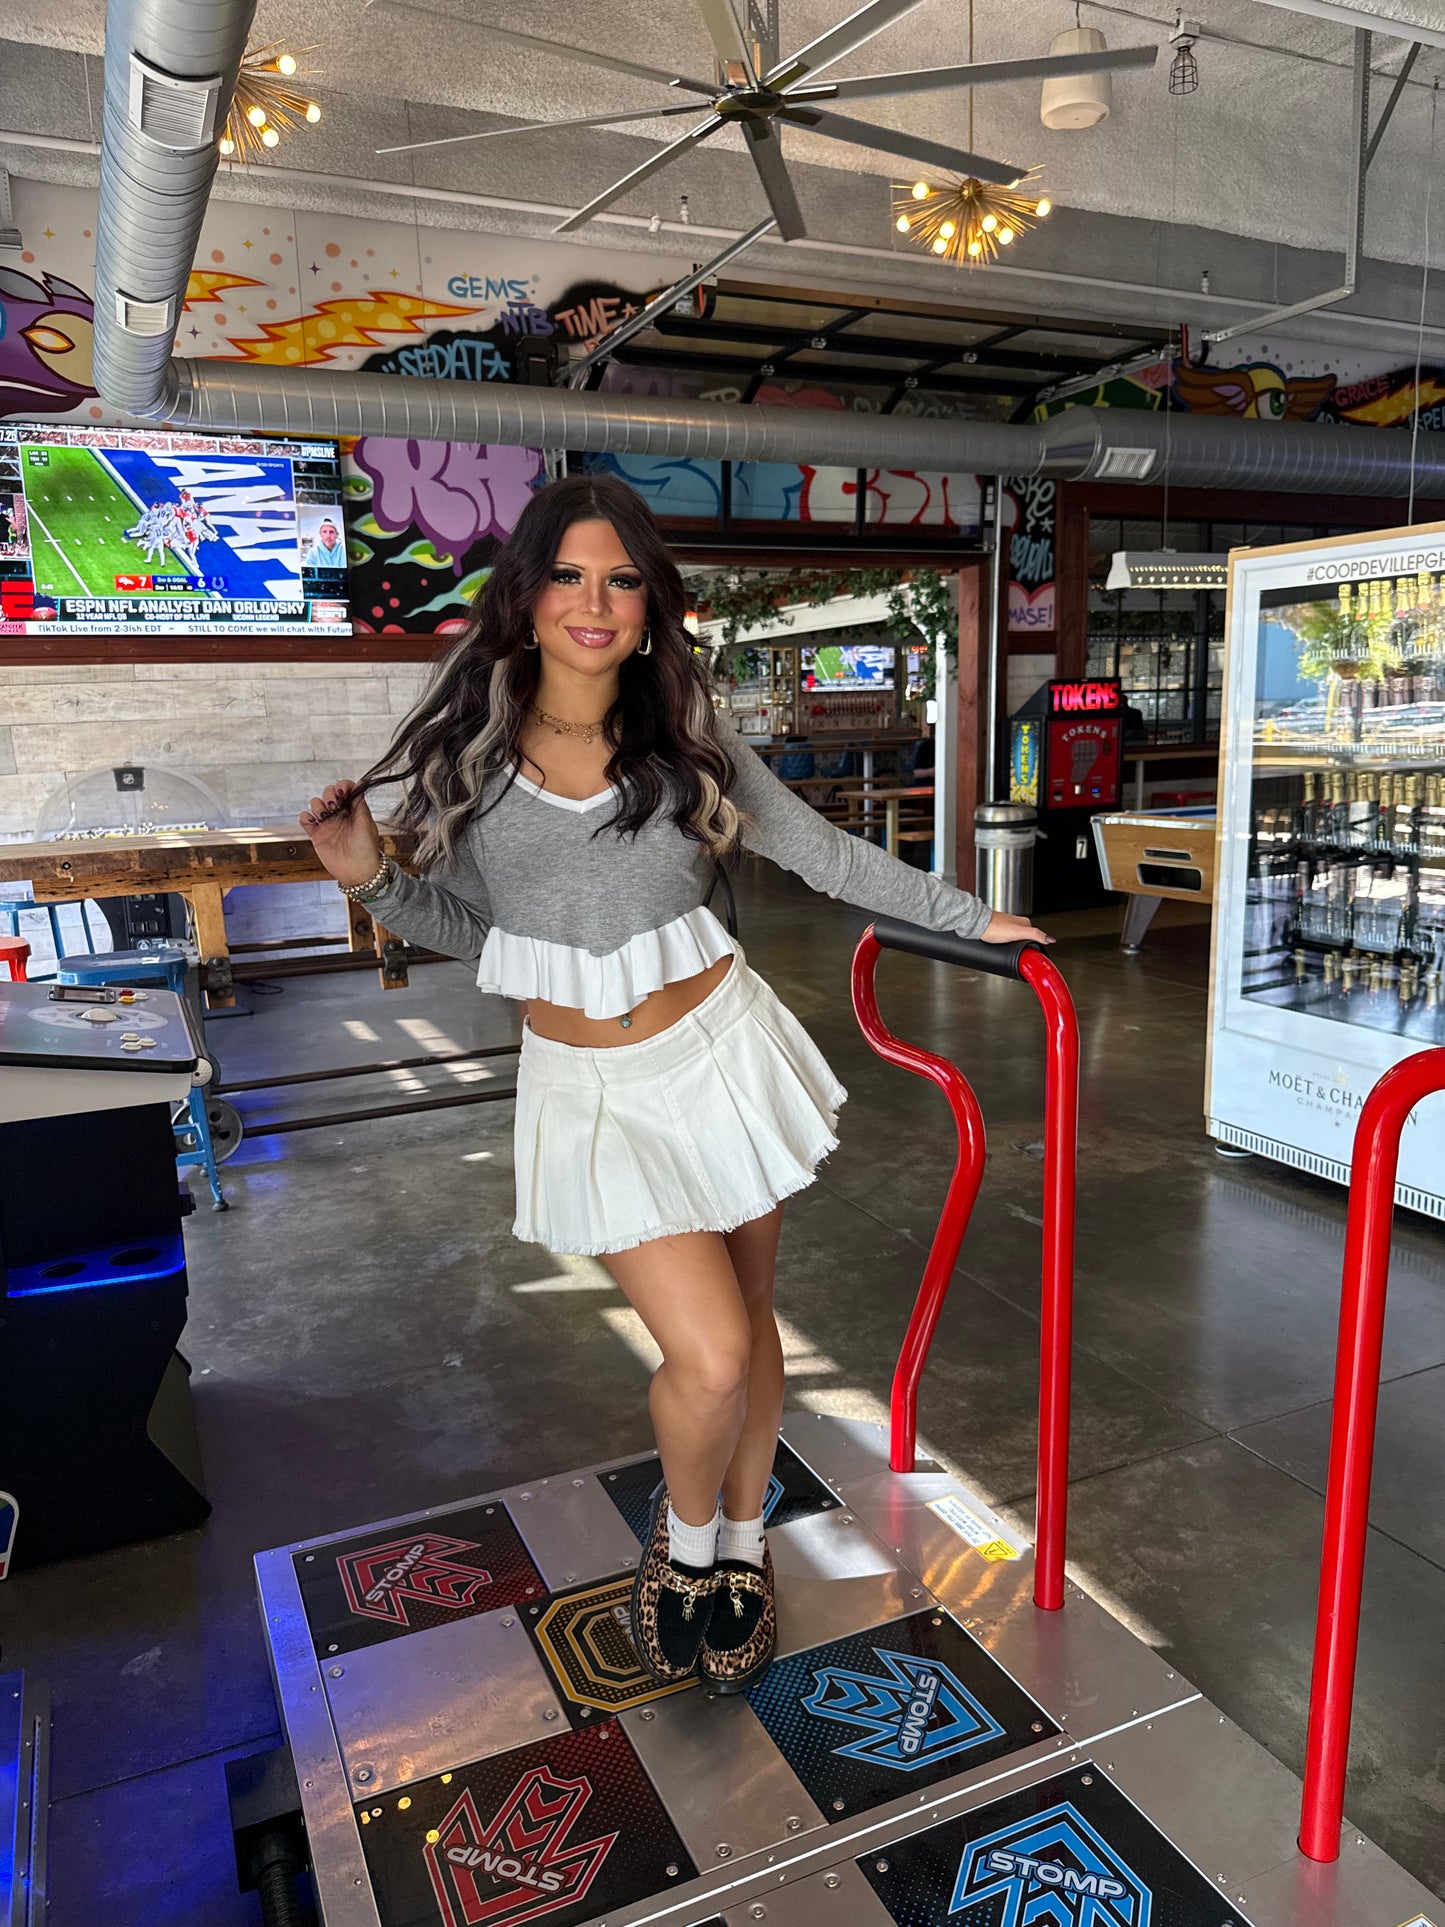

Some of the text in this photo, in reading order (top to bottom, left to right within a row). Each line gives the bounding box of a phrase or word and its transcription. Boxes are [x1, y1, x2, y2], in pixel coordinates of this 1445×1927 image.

[138, 576, 147, 587] 7
[197, 578, 206, 588] 6
[65, 599, 305, 616] ESPN NFL ANALYST DAN ORLOVSKY
[86, 613, 104, 621] YEAR
[1008, 604, 1053, 628] MASE!
[38, 624, 67, 633] TikTok
[70, 624, 88, 633] Live
[90, 624, 112, 633] from
[114, 624, 142, 633] 2-3ish
[145, 624, 162, 633] EDT
[188, 625, 212, 633] STILL
[214, 625, 225, 633] TO
[227, 625, 254, 633] COME
[270, 625, 285, 633] will
[287, 625, 306, 633] chat
[307, 625, 325, 633] with
[1050, 682, 1119, 712] TOKENS
[1061, 725, 1108, 742] TOKENS
[1021, 724, 1031, 785] TOKENS
[1078, 840, 1085, 858] 7
[1268, 1069, 1315, 1098] MOËT
[1316, 1086, 1326, 1101] &
[365, 1543, 426, 1603] STOMP
[900, 1673, 939, 1754] STOMP
[446, 1846, 566, 1893] STOMP
[990, 1850, 1125, 1898] STOMP
